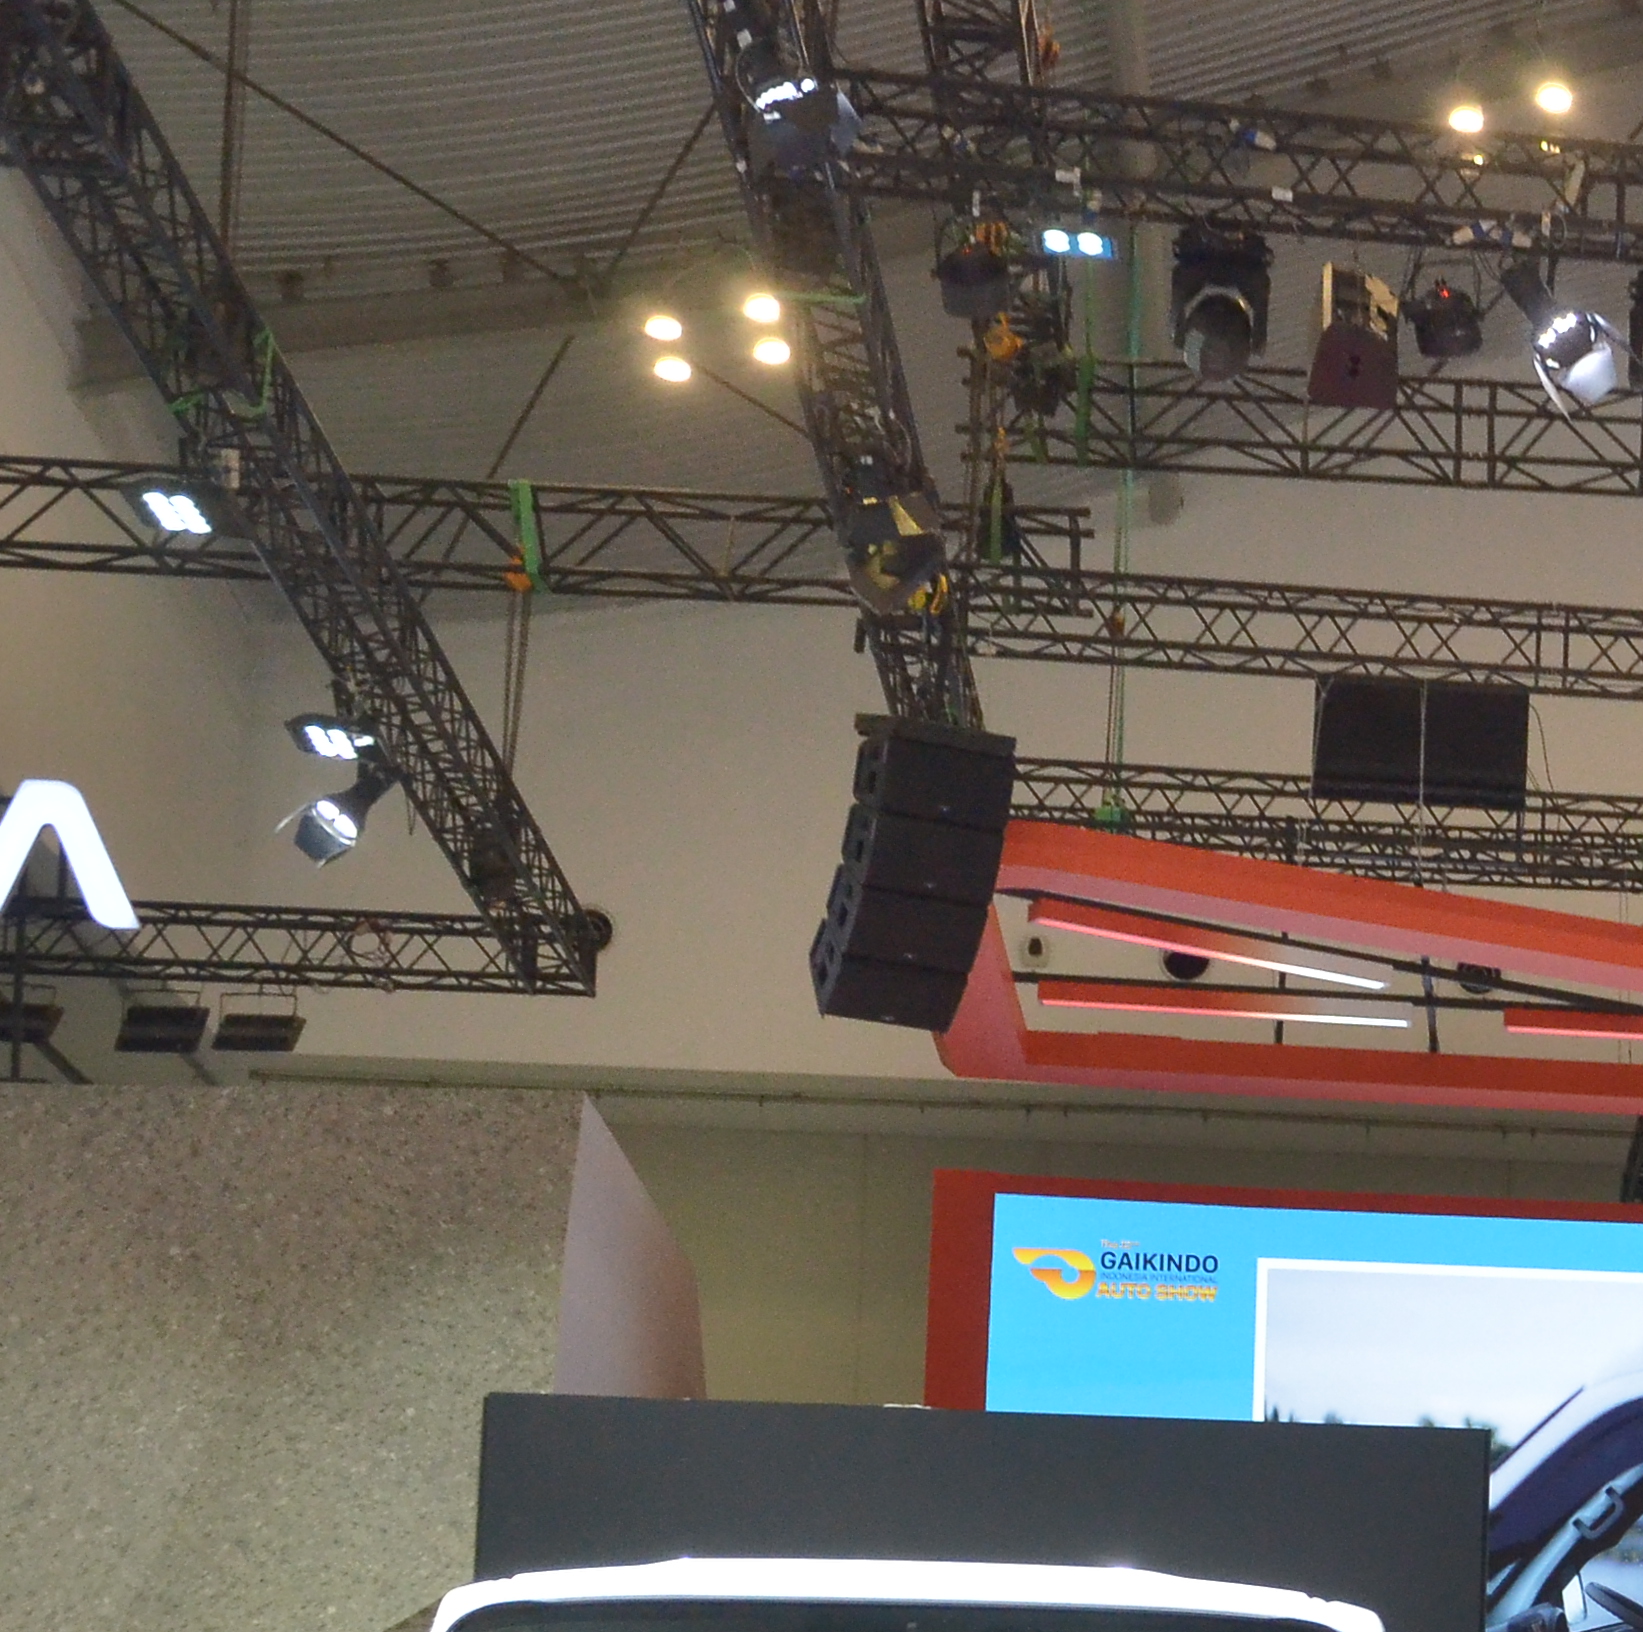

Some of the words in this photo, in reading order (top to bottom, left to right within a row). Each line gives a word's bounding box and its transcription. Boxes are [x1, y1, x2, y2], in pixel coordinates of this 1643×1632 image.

[1101, 1251, 1219, 1273] GAIKINDO
[1101, 1272, 1149, 1281] INDONESIA
[1151, 1275, 1219, 1284] INTERNATIONAL
[1096, 1282, 1151, 1299] AUTO
[1156, 1284, 1219, 1302] SHOW
